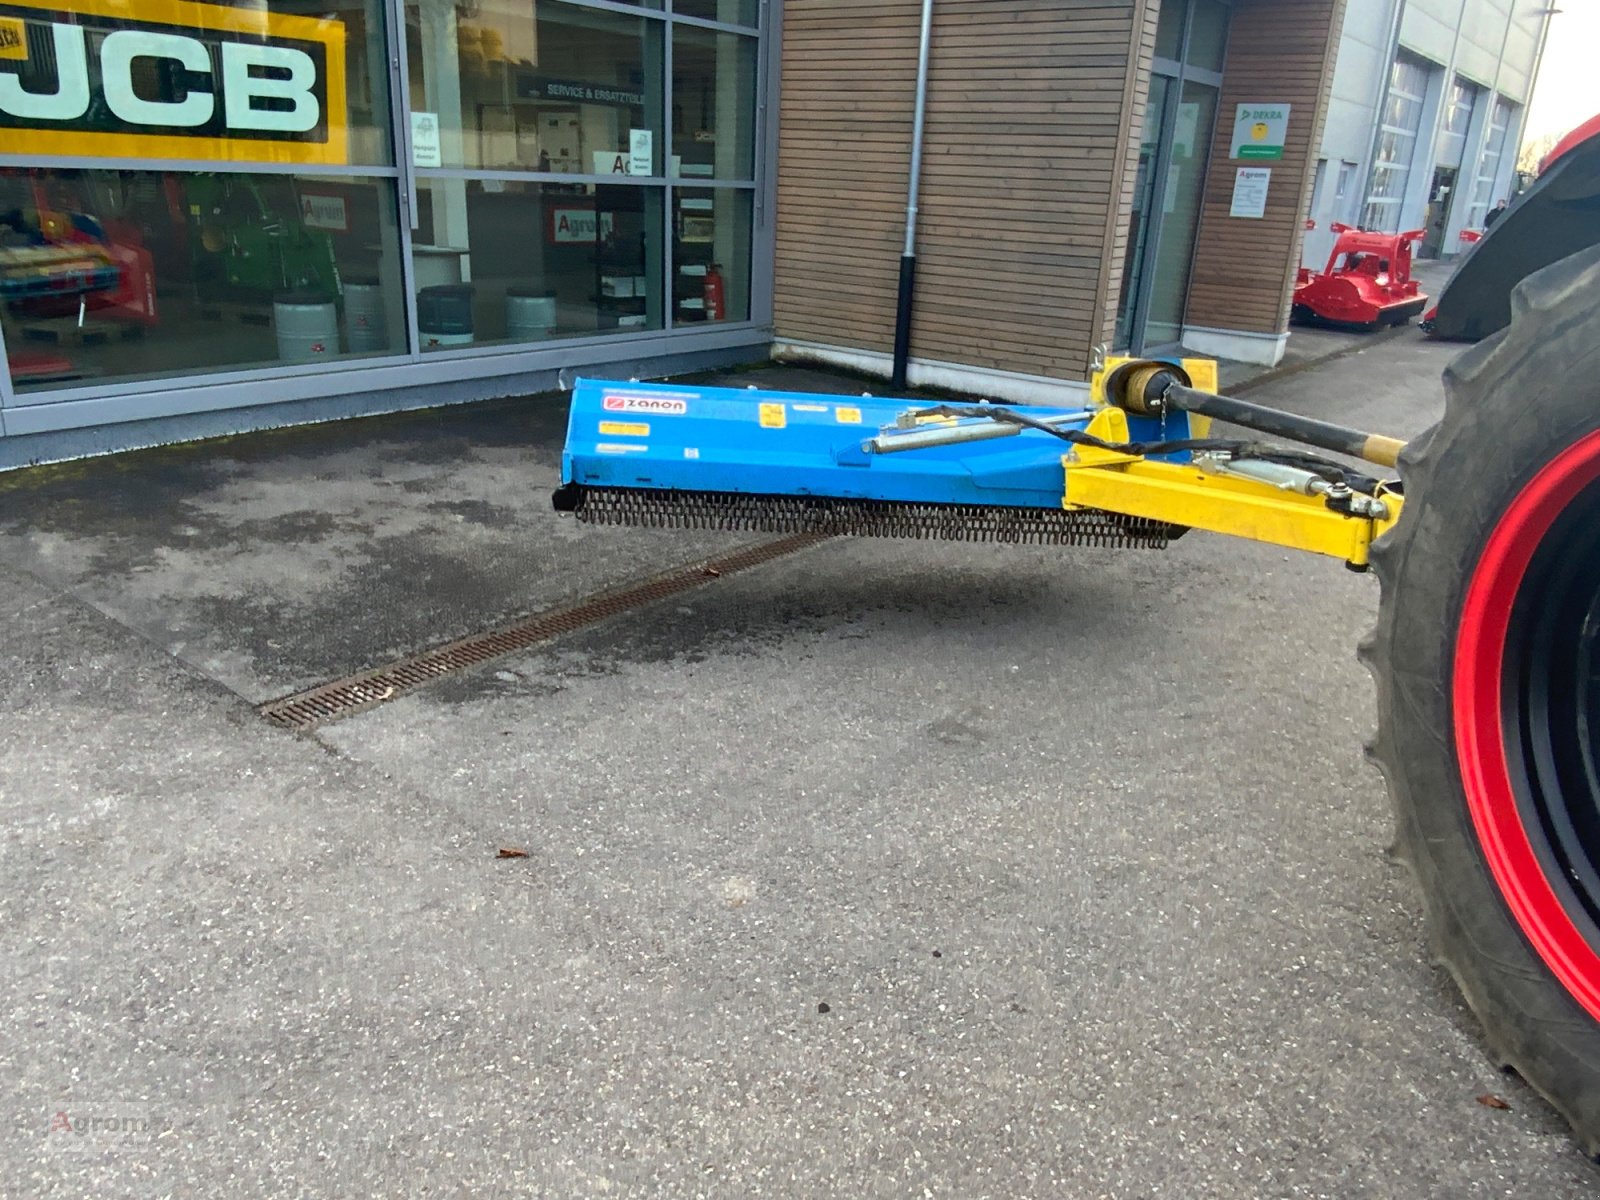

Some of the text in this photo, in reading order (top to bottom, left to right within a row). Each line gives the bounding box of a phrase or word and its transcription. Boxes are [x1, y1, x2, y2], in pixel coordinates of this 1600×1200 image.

[0, 22, 320, 132] JCB
[547, 84, 583, 98] SERVICE
[586, 88, 593, 99] &
[1252, 110, 1283, 120] DEKRA
[1239, 170, 1267, 180] Agrom
